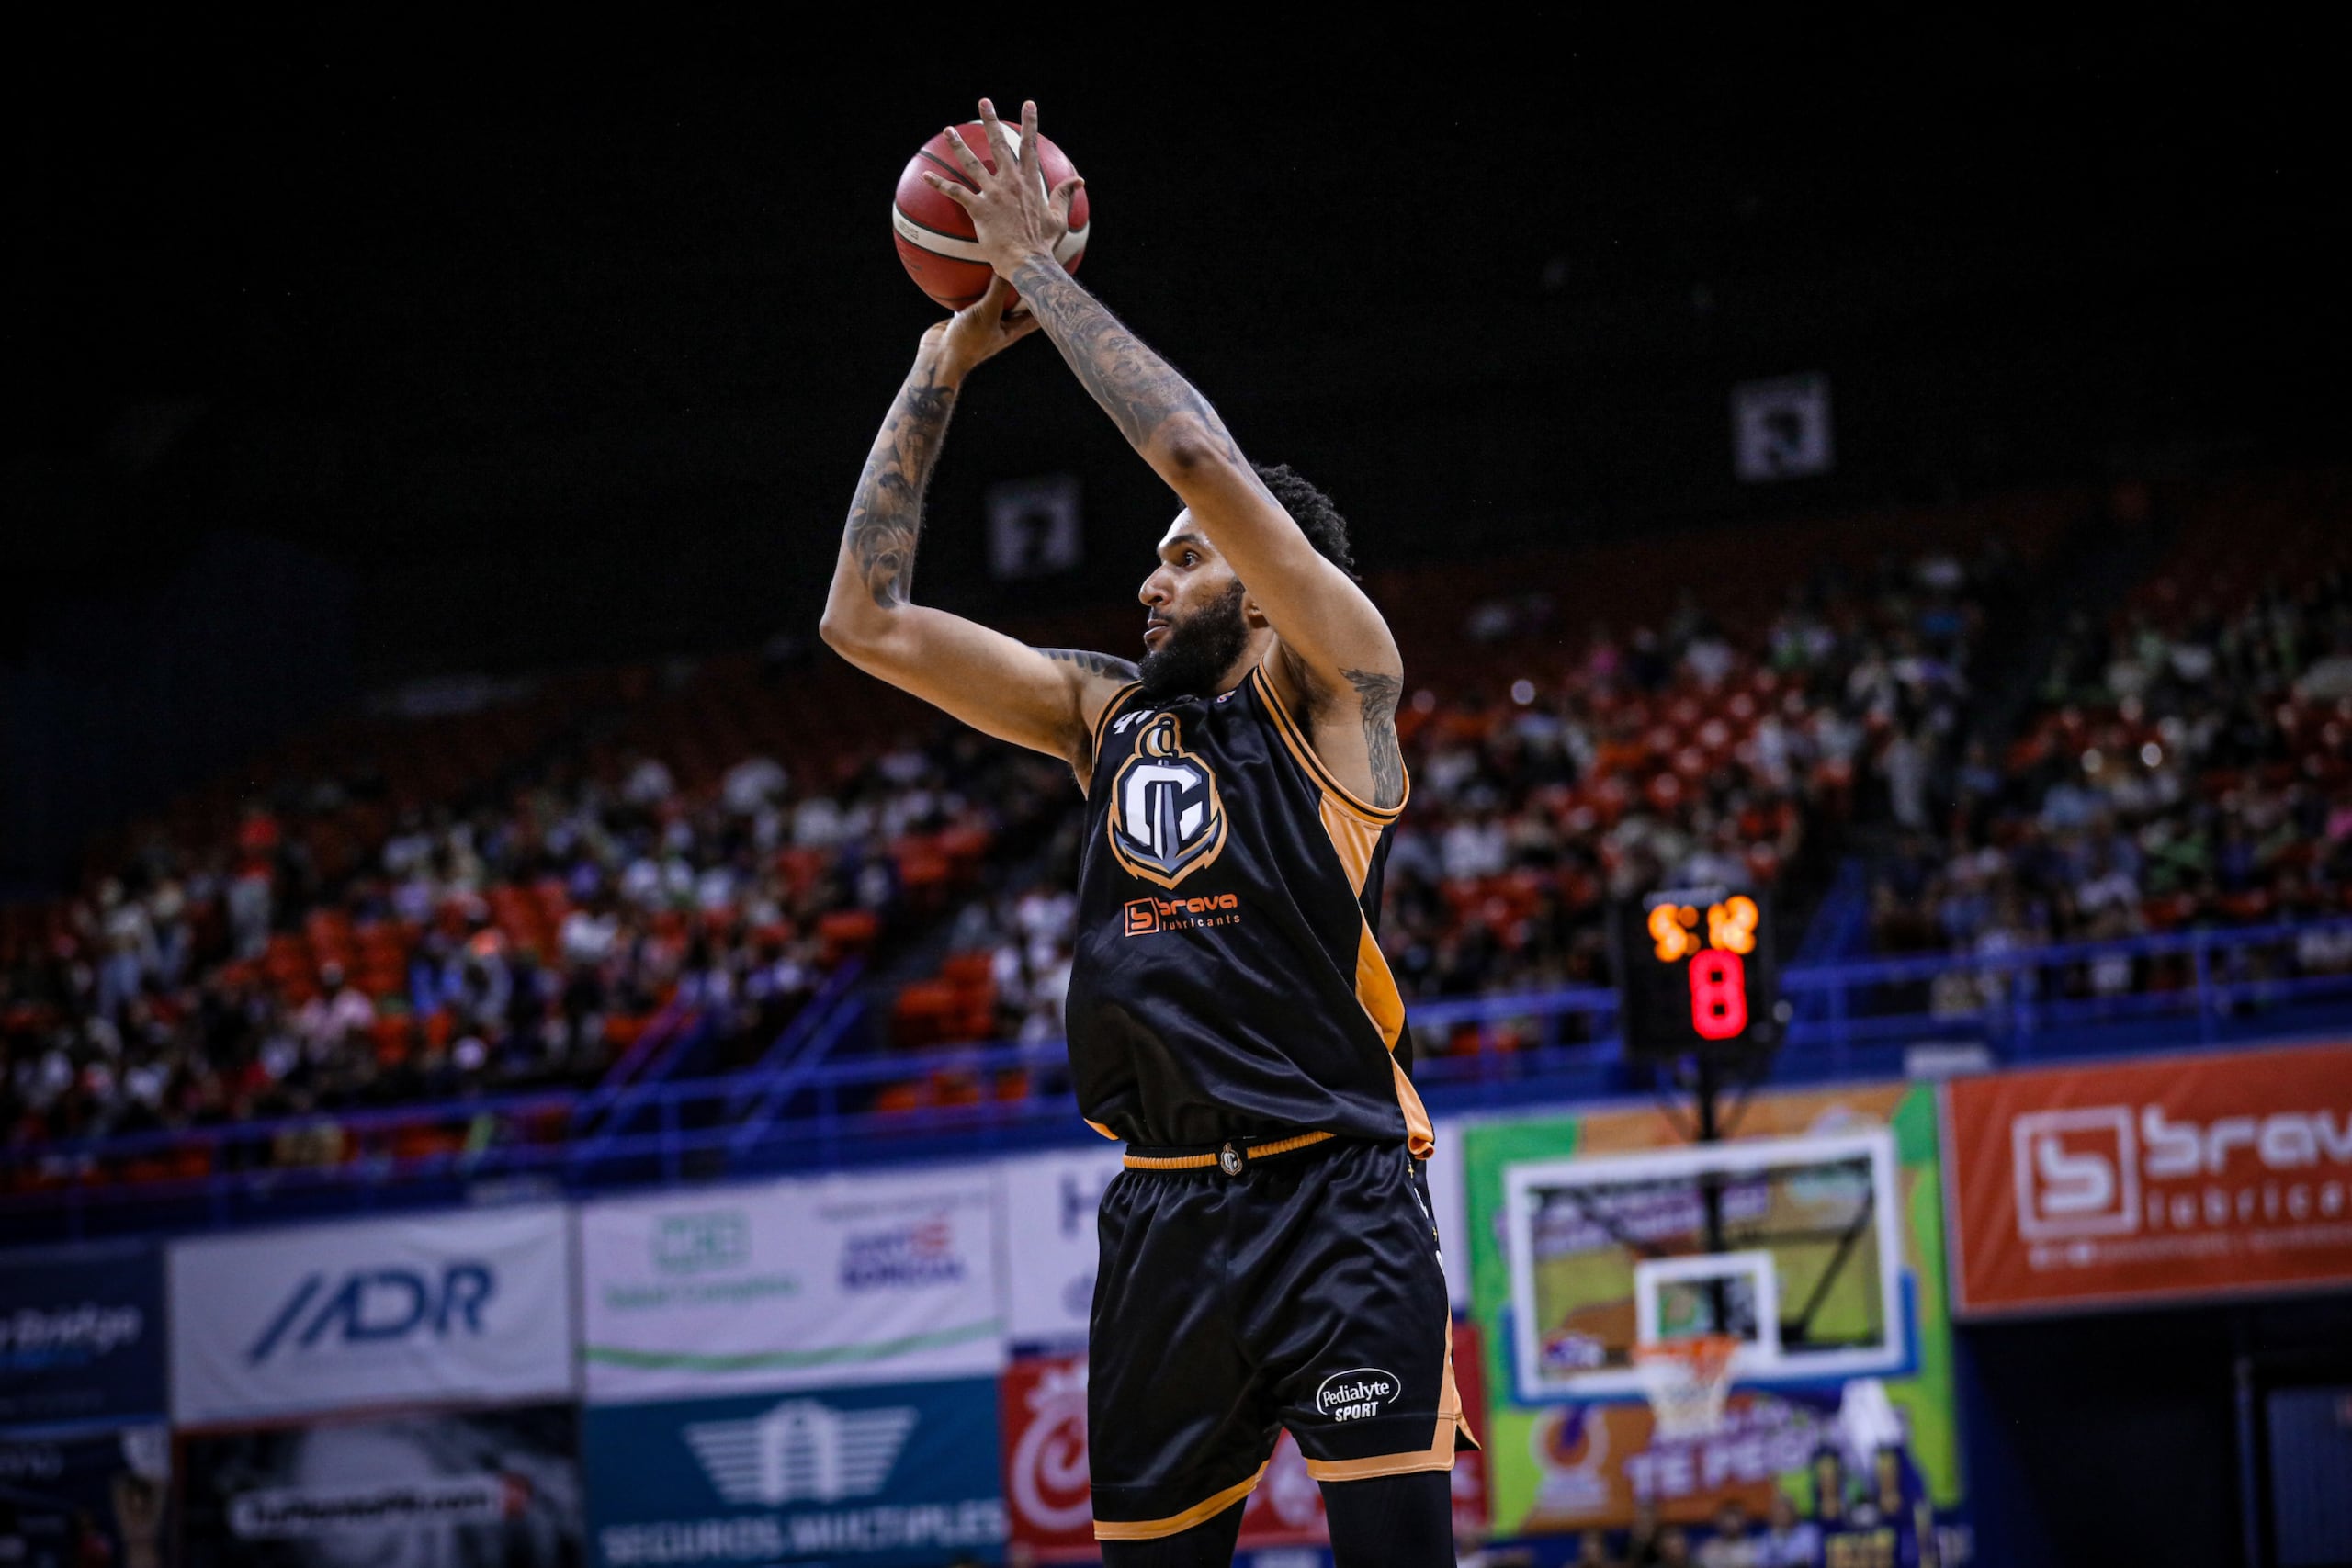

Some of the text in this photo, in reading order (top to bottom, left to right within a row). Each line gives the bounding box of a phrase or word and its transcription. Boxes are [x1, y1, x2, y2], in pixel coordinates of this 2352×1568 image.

[1155, 893, 1238, 916] brava
[1162, 914, 1240, 931] lubricants
[1689, 949, 1748, 1040] 8
[1322, 1381, 1390, 1407] Pedialyte
[1335, 1401, 1379, 1422] SPORT
